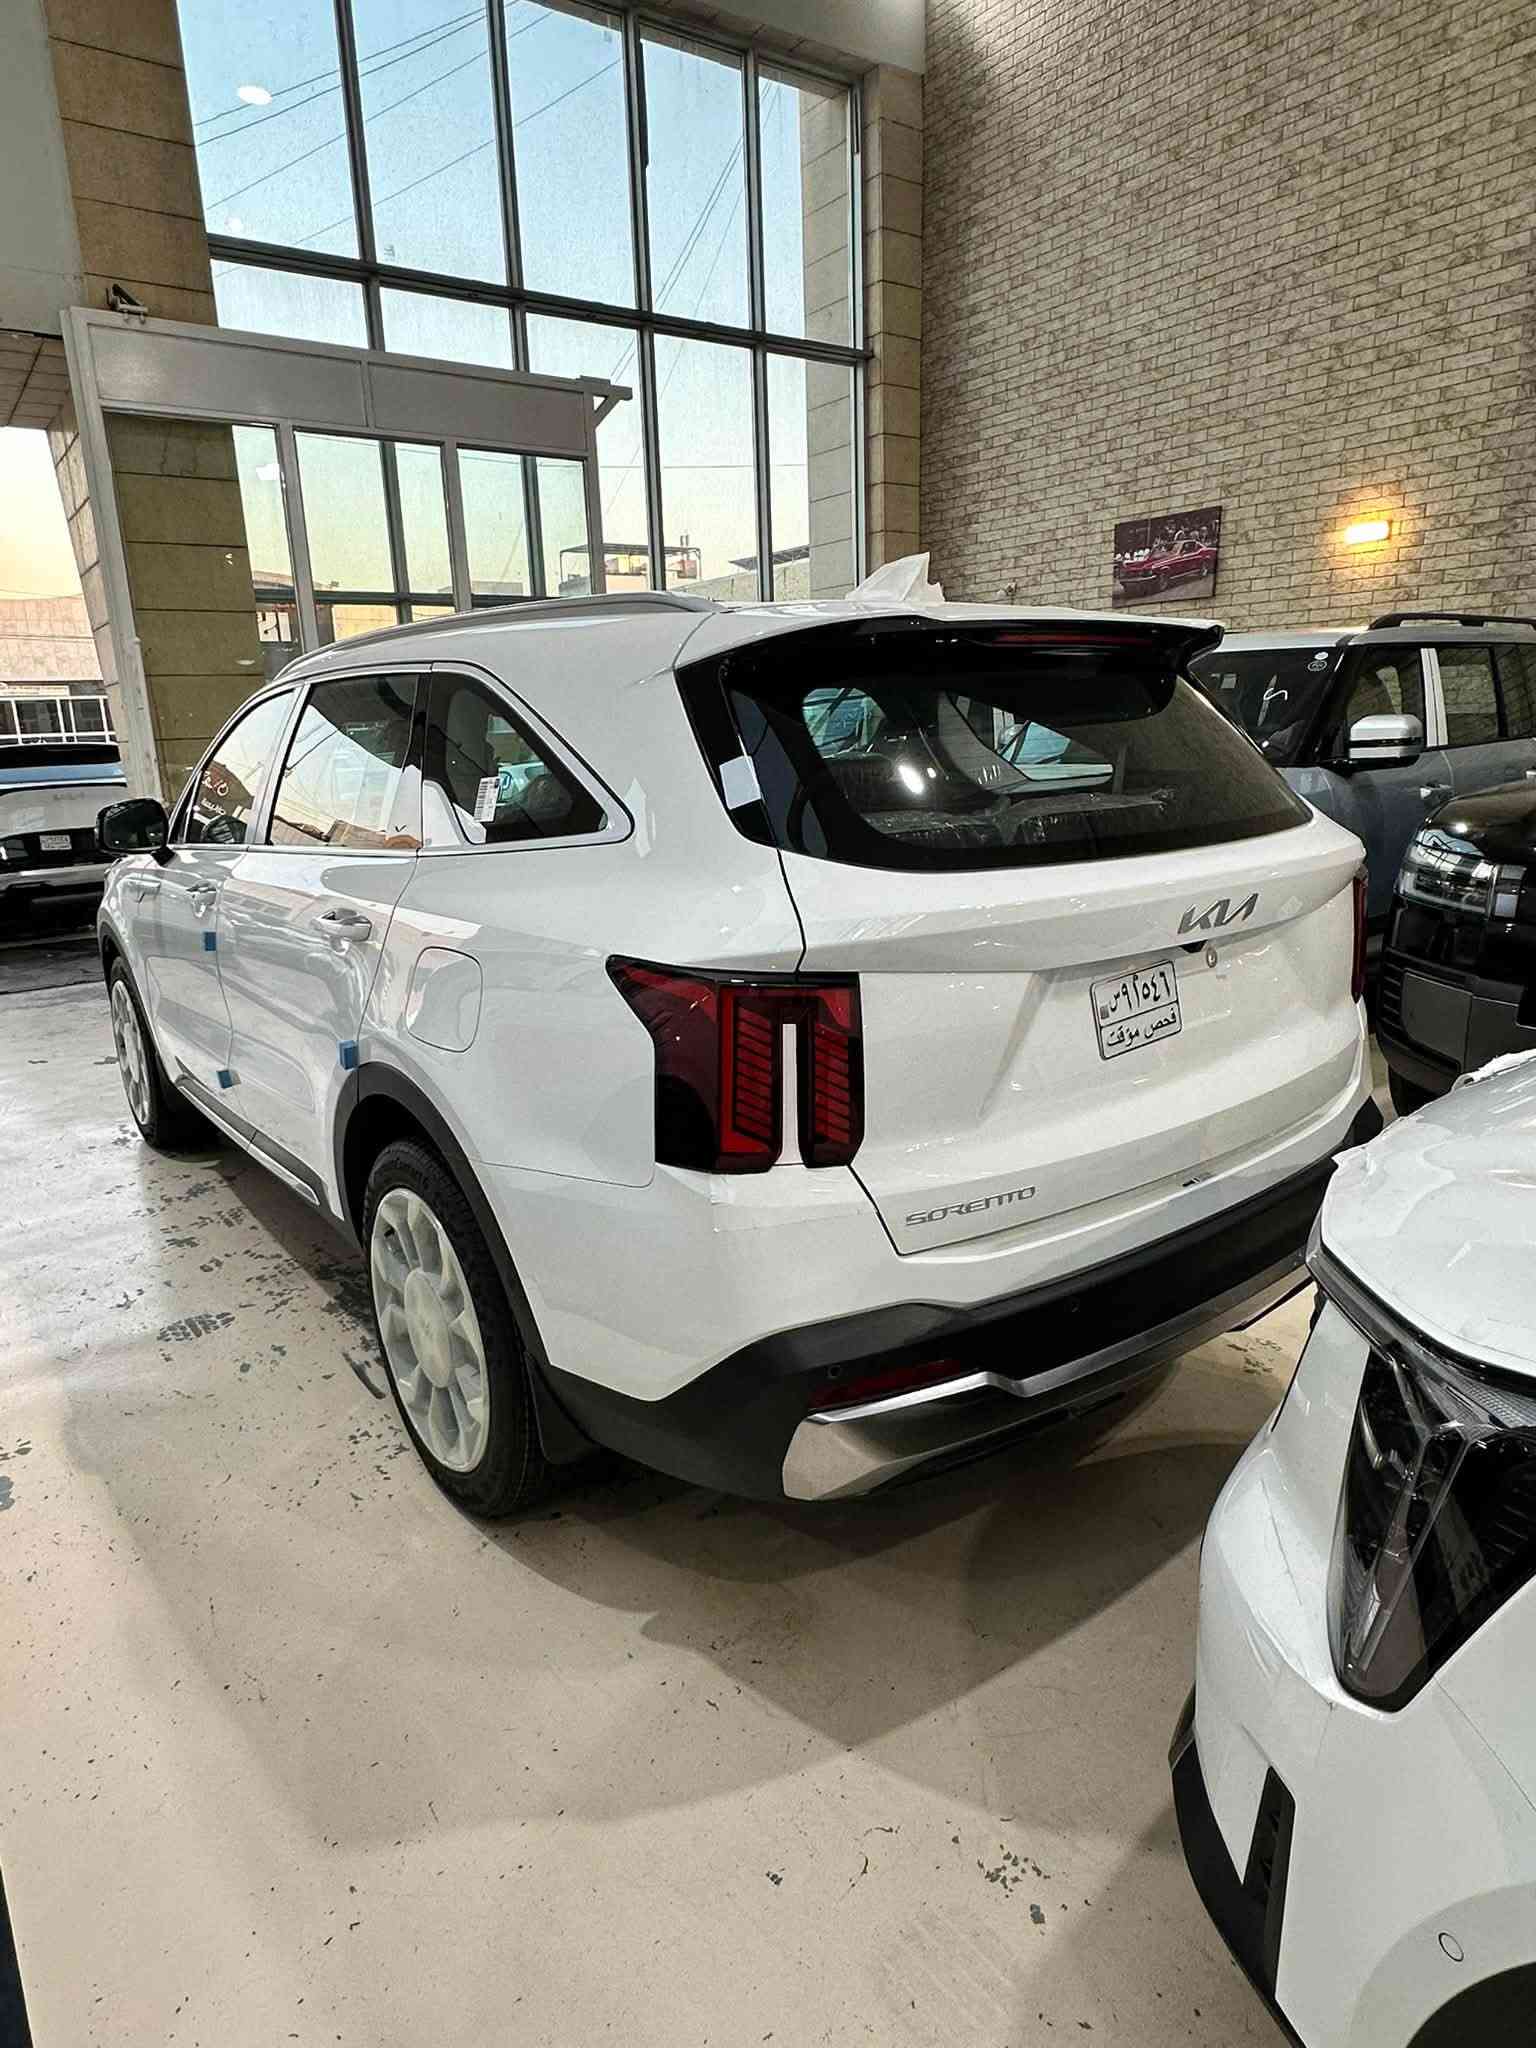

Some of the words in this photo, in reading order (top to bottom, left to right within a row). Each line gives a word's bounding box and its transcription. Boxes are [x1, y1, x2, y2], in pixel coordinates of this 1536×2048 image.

[1178, 892, 1259, 934] KIA
[1144, 1006, 1177, 1039] فحص
[905, 1185, 1037, 1226] SORENTO
